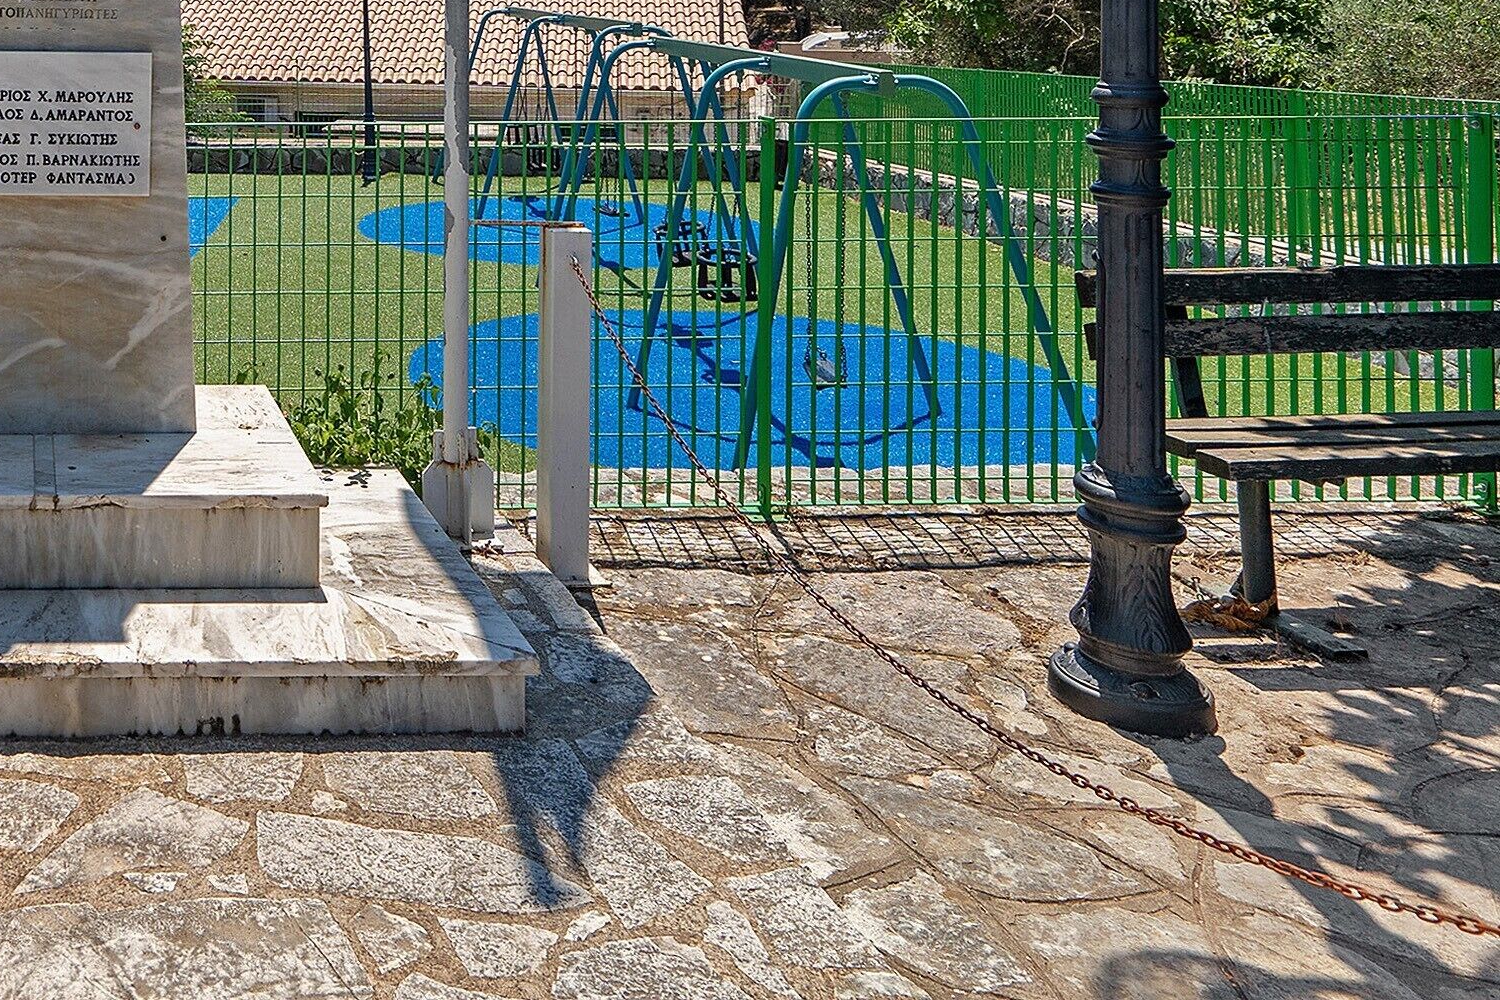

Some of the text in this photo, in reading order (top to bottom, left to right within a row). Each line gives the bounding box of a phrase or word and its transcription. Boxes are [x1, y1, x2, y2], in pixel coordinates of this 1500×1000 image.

[30, 133, 42, 145] Γ.
[47, 133, 118, 146] ΣΥΚΙΩΤΗΣ
[46, 172, 136, 185] ΦΑΝΤΑΣΜΑ)
